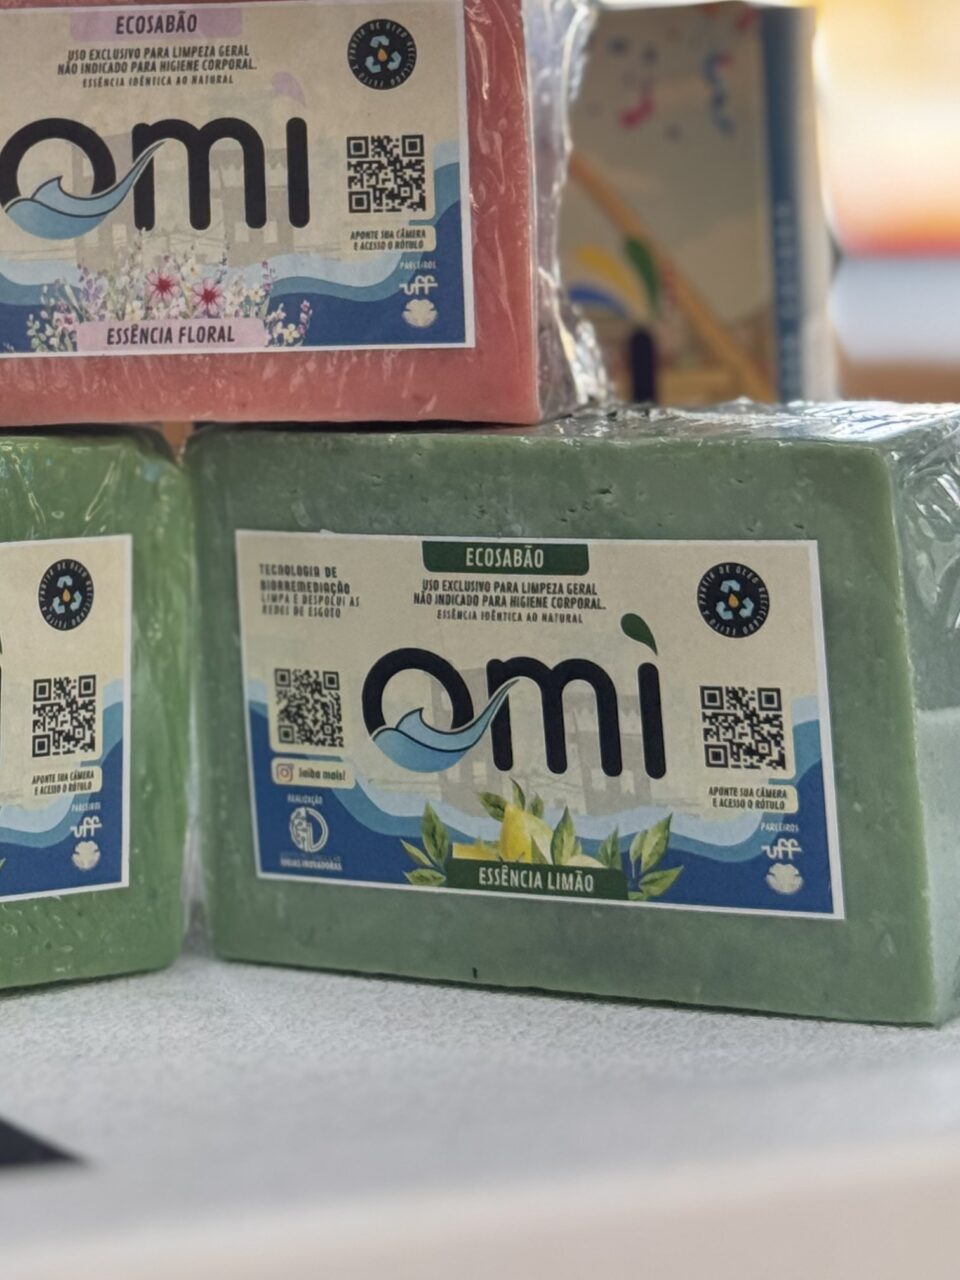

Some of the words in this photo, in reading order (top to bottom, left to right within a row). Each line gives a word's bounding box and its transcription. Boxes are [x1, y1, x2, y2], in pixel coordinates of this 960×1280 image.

[115, 10, 198, 35] ECOSABÃO
[68, 49, 86, 62] USO
[89, 47, 141, 61] EXCLUSIVO
[143, 46, 170, 59] PARA
[172, 45, 216, 59] LIMPEZA
[218, 44, 250, 57] GERAL
[57, 60, 78, 75] NÃO
[80, 61, 127, 74] INDICADO
[130, 61, 157, 73] PARA
[159, 59, 199, 72] HIGIENE
[201, 58, 257, 71] CORPORAL.
[82, 76, 125, 88] ESSÊNCIA
[129, 75, 172, 87] IDÊNTICA
[176, 75, 188, 86] AO
[191, 74, 234, 85] NATURAL
[106, 324, 174, 345] ESSÊNCIA
[177, 324, 236, 344] FLORAL
[466, 545, 544, 568] ECOSABÃO
[259, 563, 320, 577] TECNOLOGIA
[324, 566, 337, 578] DE
[422, 579, 439, 592] USO
[441, 579, 491, 593] EXCLUSIVO
[493, 581, 519, 594] PARA
[521, 582, 564, 595] LIMPEZA
[566, 583, 598, 596] GERAL
[293, 593, 298, 604] E
[349, 596, 360, 607] AS
[413, 590, 433, 605] NÃO
[435, 593, 479, 607] INDICADO
[482, 594, 507, 607] PARA
[510, 595, 548, 608] HIGIENE
[551, 596, 606, 610] CORPORAL.
[437, 608, 477, 621] ESSÊNCIA
[481, 609, 522, 622] IDÊNTICA
[526, 612, 538, 622] AO
[542, 613, 583, 624] NATURAL
[708, 786, 738, 797] APONTE
[740, 787, 754, 798] SUA
[756, 787, 787, 798] CÂMERA
[478, 866, 542, 888] ESSÊNCIA
[547, 870, 594, 892] LIMÃO
